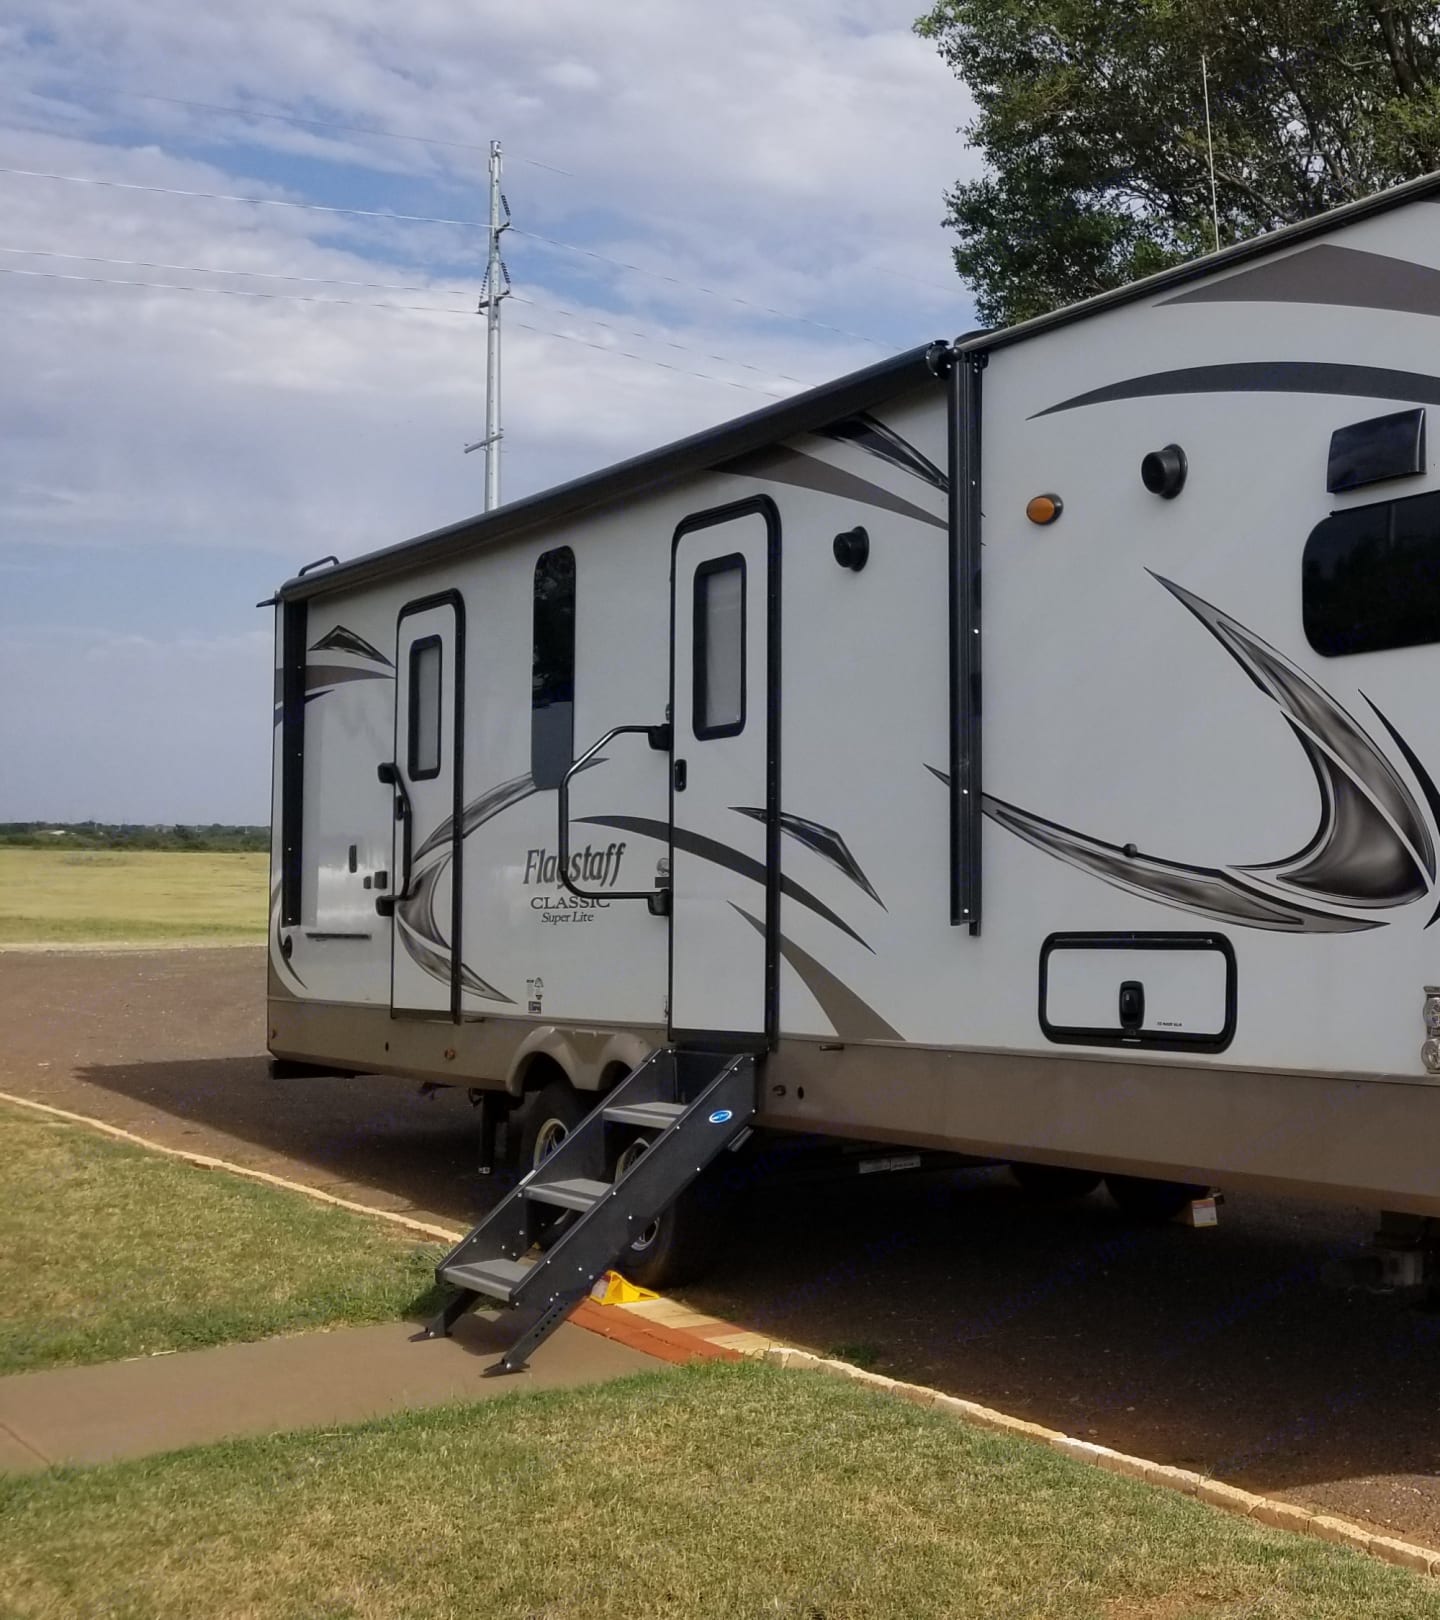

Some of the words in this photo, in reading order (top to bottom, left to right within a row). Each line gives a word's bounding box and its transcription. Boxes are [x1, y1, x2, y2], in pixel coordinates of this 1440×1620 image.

[530, 896, 610, 910] CLASSIC
[541, 911, 571, 926] Super
[572, 911, 595, 923] Lite
